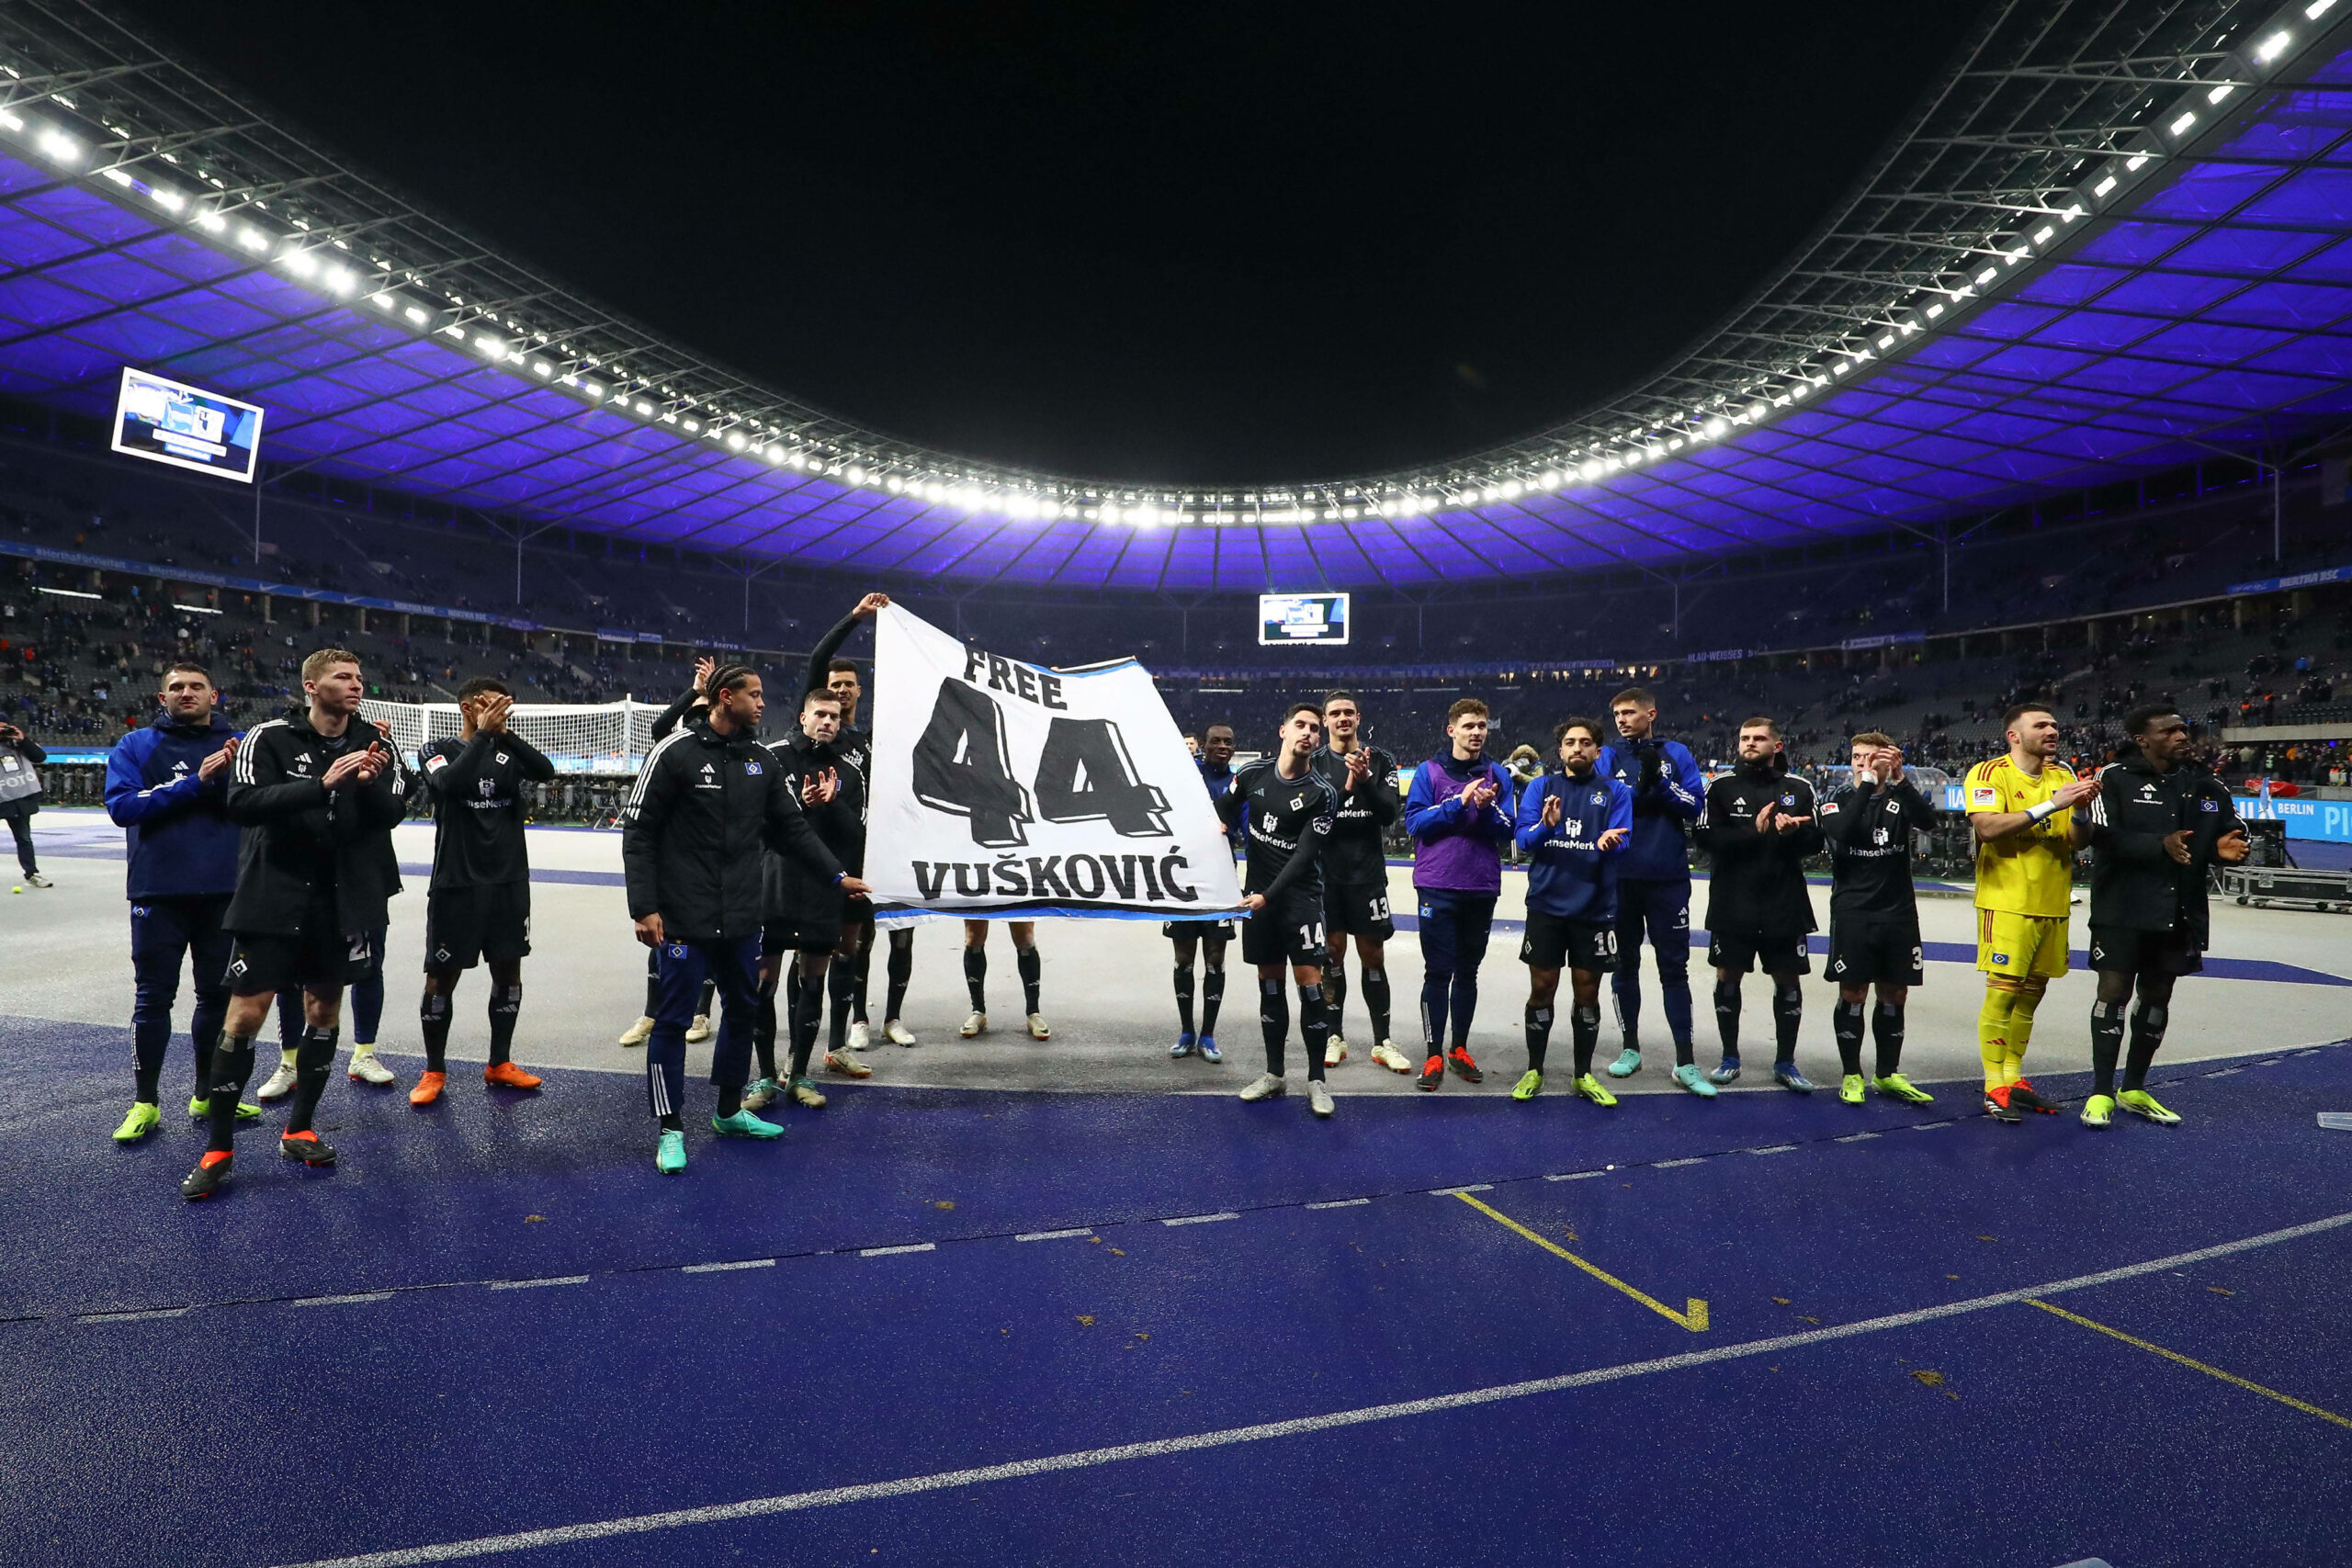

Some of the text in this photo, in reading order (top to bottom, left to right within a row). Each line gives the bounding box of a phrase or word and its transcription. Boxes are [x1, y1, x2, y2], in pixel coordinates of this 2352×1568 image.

[963, 644, 1069, 710] FREE
[912, 676, 1174, 849] 44
[2278, 803, 2314, 816] BERLIN
[911, 845, 1199, 902] VUŠKOVIĆ
[1369, 897, 1390, 921] 13
[1299, 921, 1326, 950] 14
[1594, 930, 1618, 956] 10
